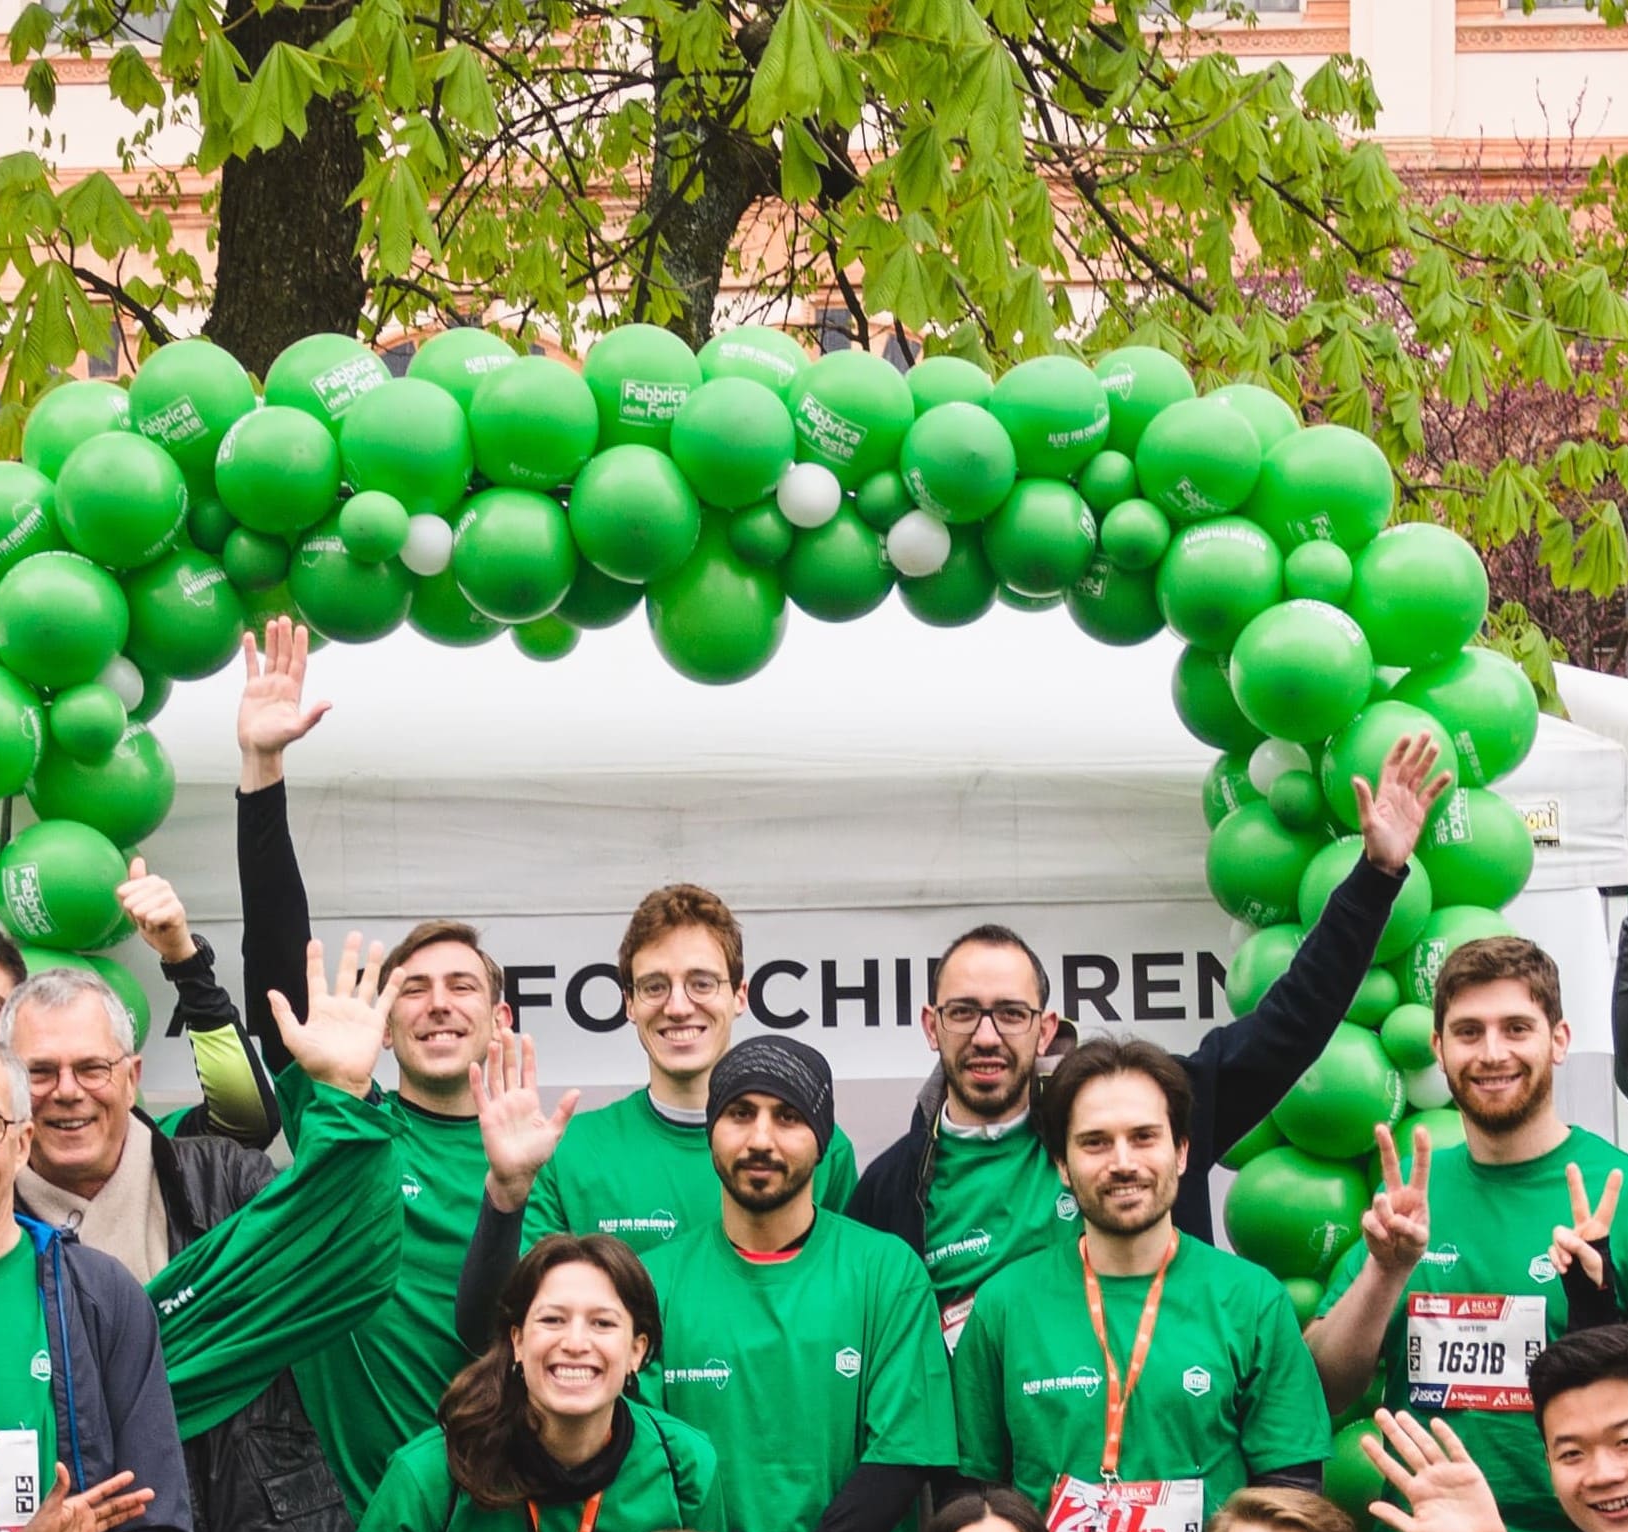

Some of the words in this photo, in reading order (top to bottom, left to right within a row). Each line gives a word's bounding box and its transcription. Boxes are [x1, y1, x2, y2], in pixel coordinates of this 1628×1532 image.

[315, 355, 378, 395] Fabbrica
[624, 383, 688, 404] Fabbrica
[799, 396, 862, 446] Fabbrica
[811, 425, 856, 459] Feste
[18, 865, 53, 935] Fabbrica
[502, 962, 631, 1034] FO
[746, 950, 1229, 1030] CHIREN
[1437, 1340, 1506, 1376] 1631B
